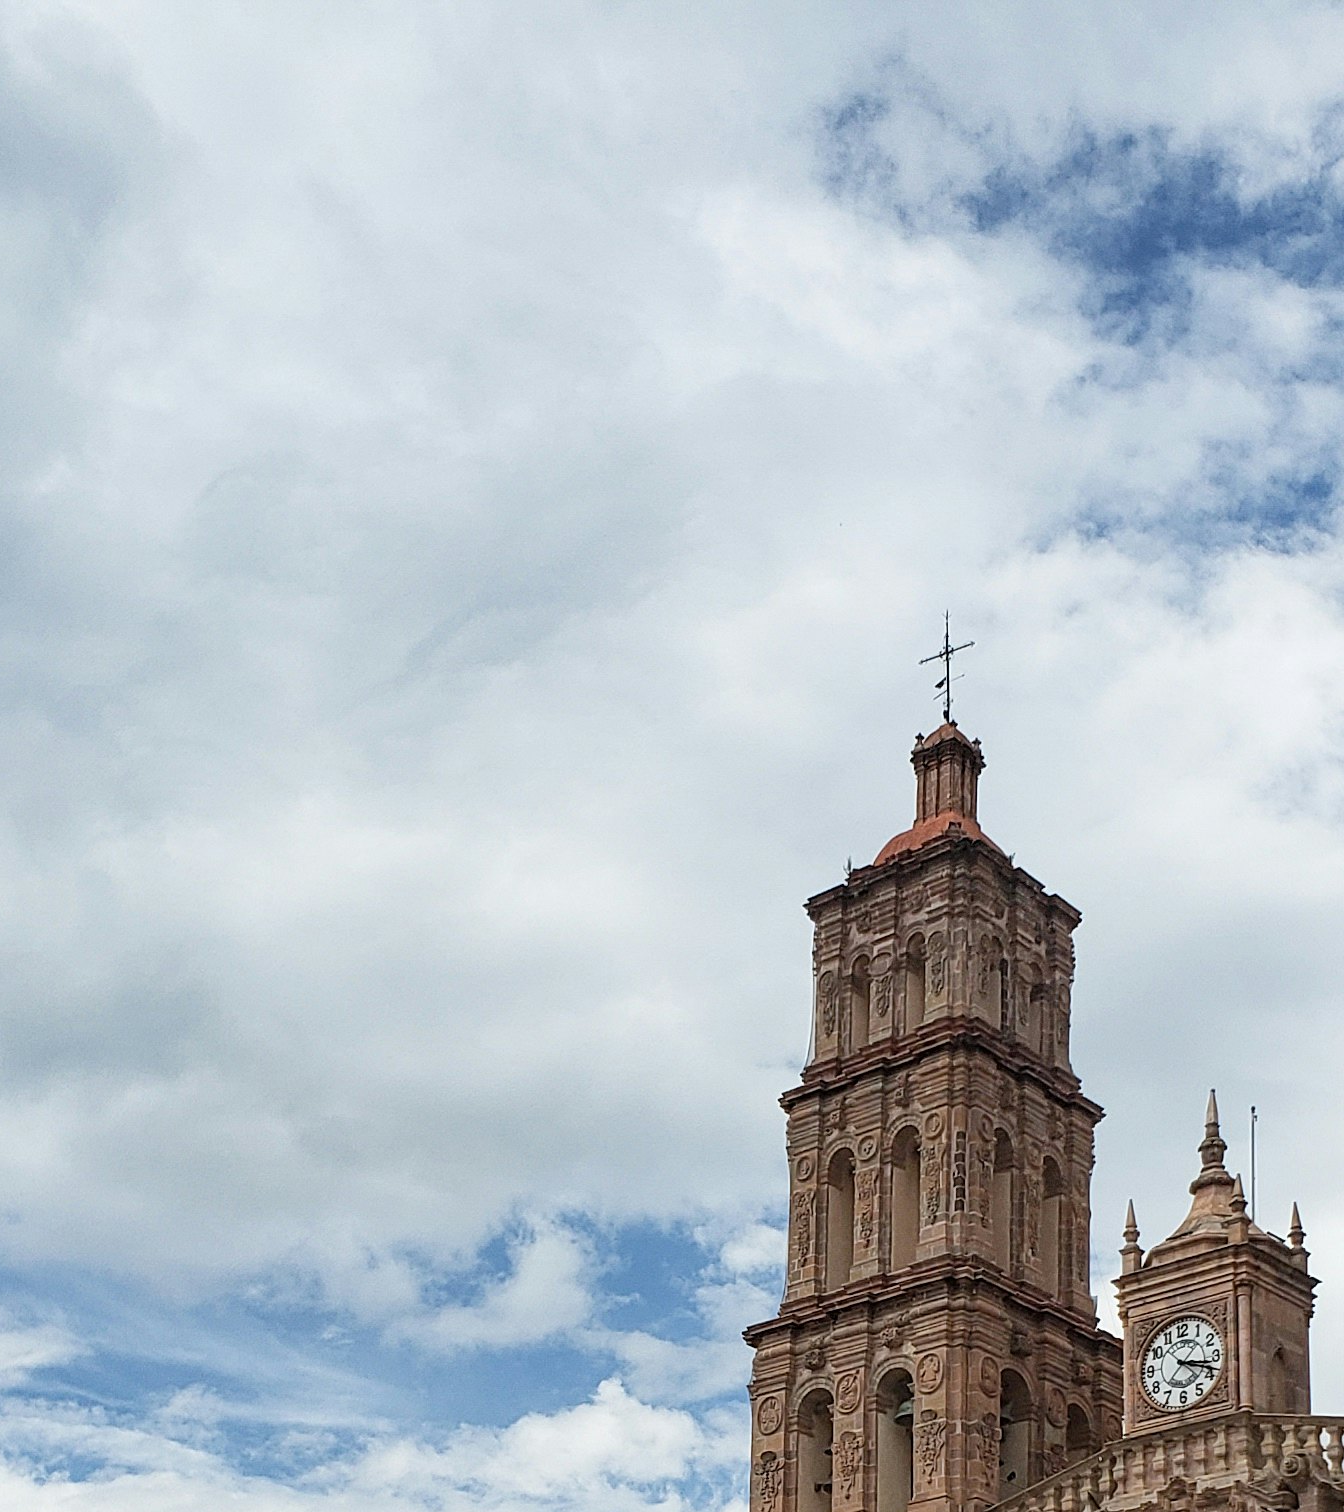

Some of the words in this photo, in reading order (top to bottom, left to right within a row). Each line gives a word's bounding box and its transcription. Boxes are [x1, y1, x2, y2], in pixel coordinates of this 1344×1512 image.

[1176, 1324, 1189, 1338] 12
[1195, 1324, 1200, 1337] 1
[1163, 1331, 1173, 1345] 11
[1206, 1333, 1215, 1347] 2
[1152, 1346, 1163, 1360] 10
[1212, 1349, 1220, 1362] 3
[1147, 1365, 1155, 1378] 9
[1205, 1368, 1215, 1381] 4
[1152, 1381, 1160, 1394] 8
[1195, 1383, 1204, 1396] 5
[1164, 1390, 1172, 1404] 7
[1179, 1391, 1188, 1404] 6
